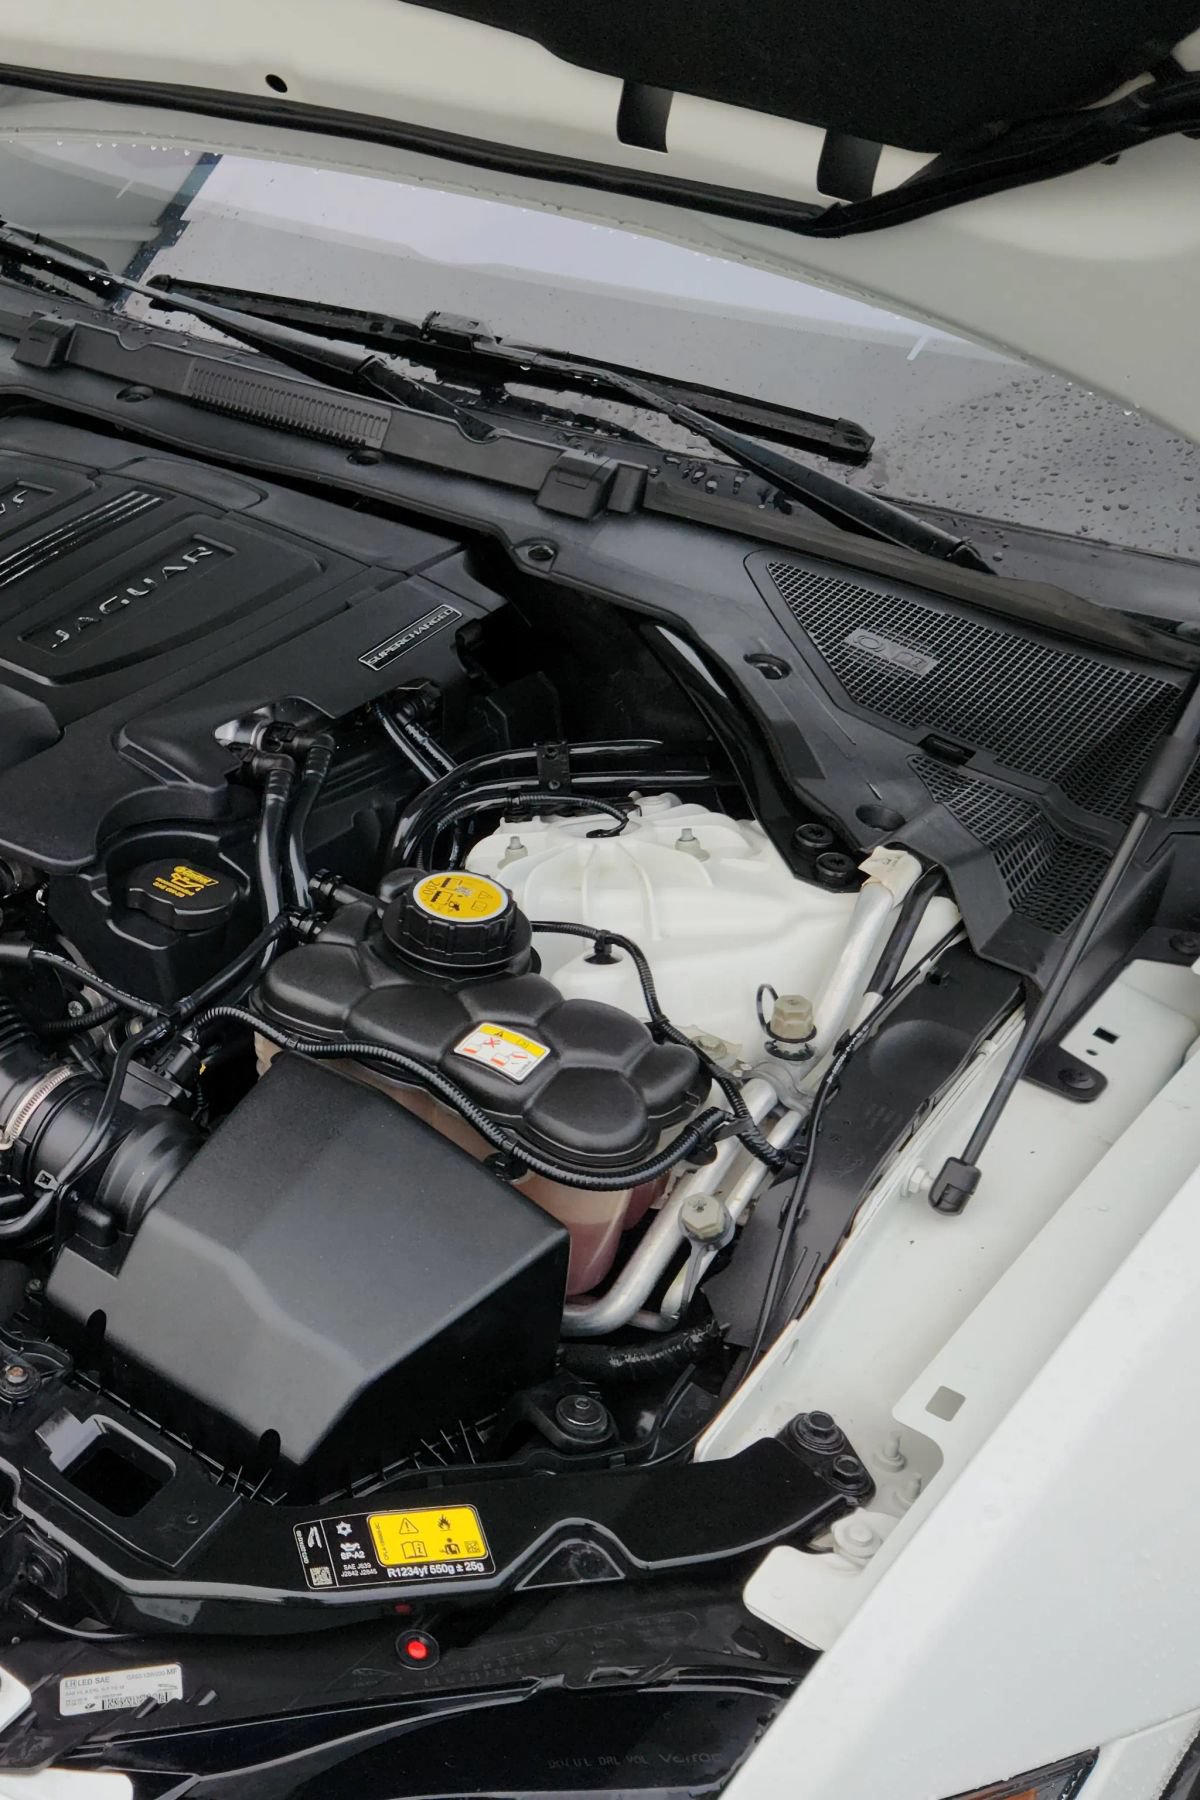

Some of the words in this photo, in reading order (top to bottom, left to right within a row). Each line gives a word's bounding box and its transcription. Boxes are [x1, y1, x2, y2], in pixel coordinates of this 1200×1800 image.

[51, 546, 213, 649] JAGUAR
[367, 608, 454, 665] SUPERCHARGED
[386, 1565, 429, 1578] R1234yf
[463, 1561, 485, 1572] 25g
[77, 1678, 93, 1687] LED
[95, 1676, 111, 1684] SAE
